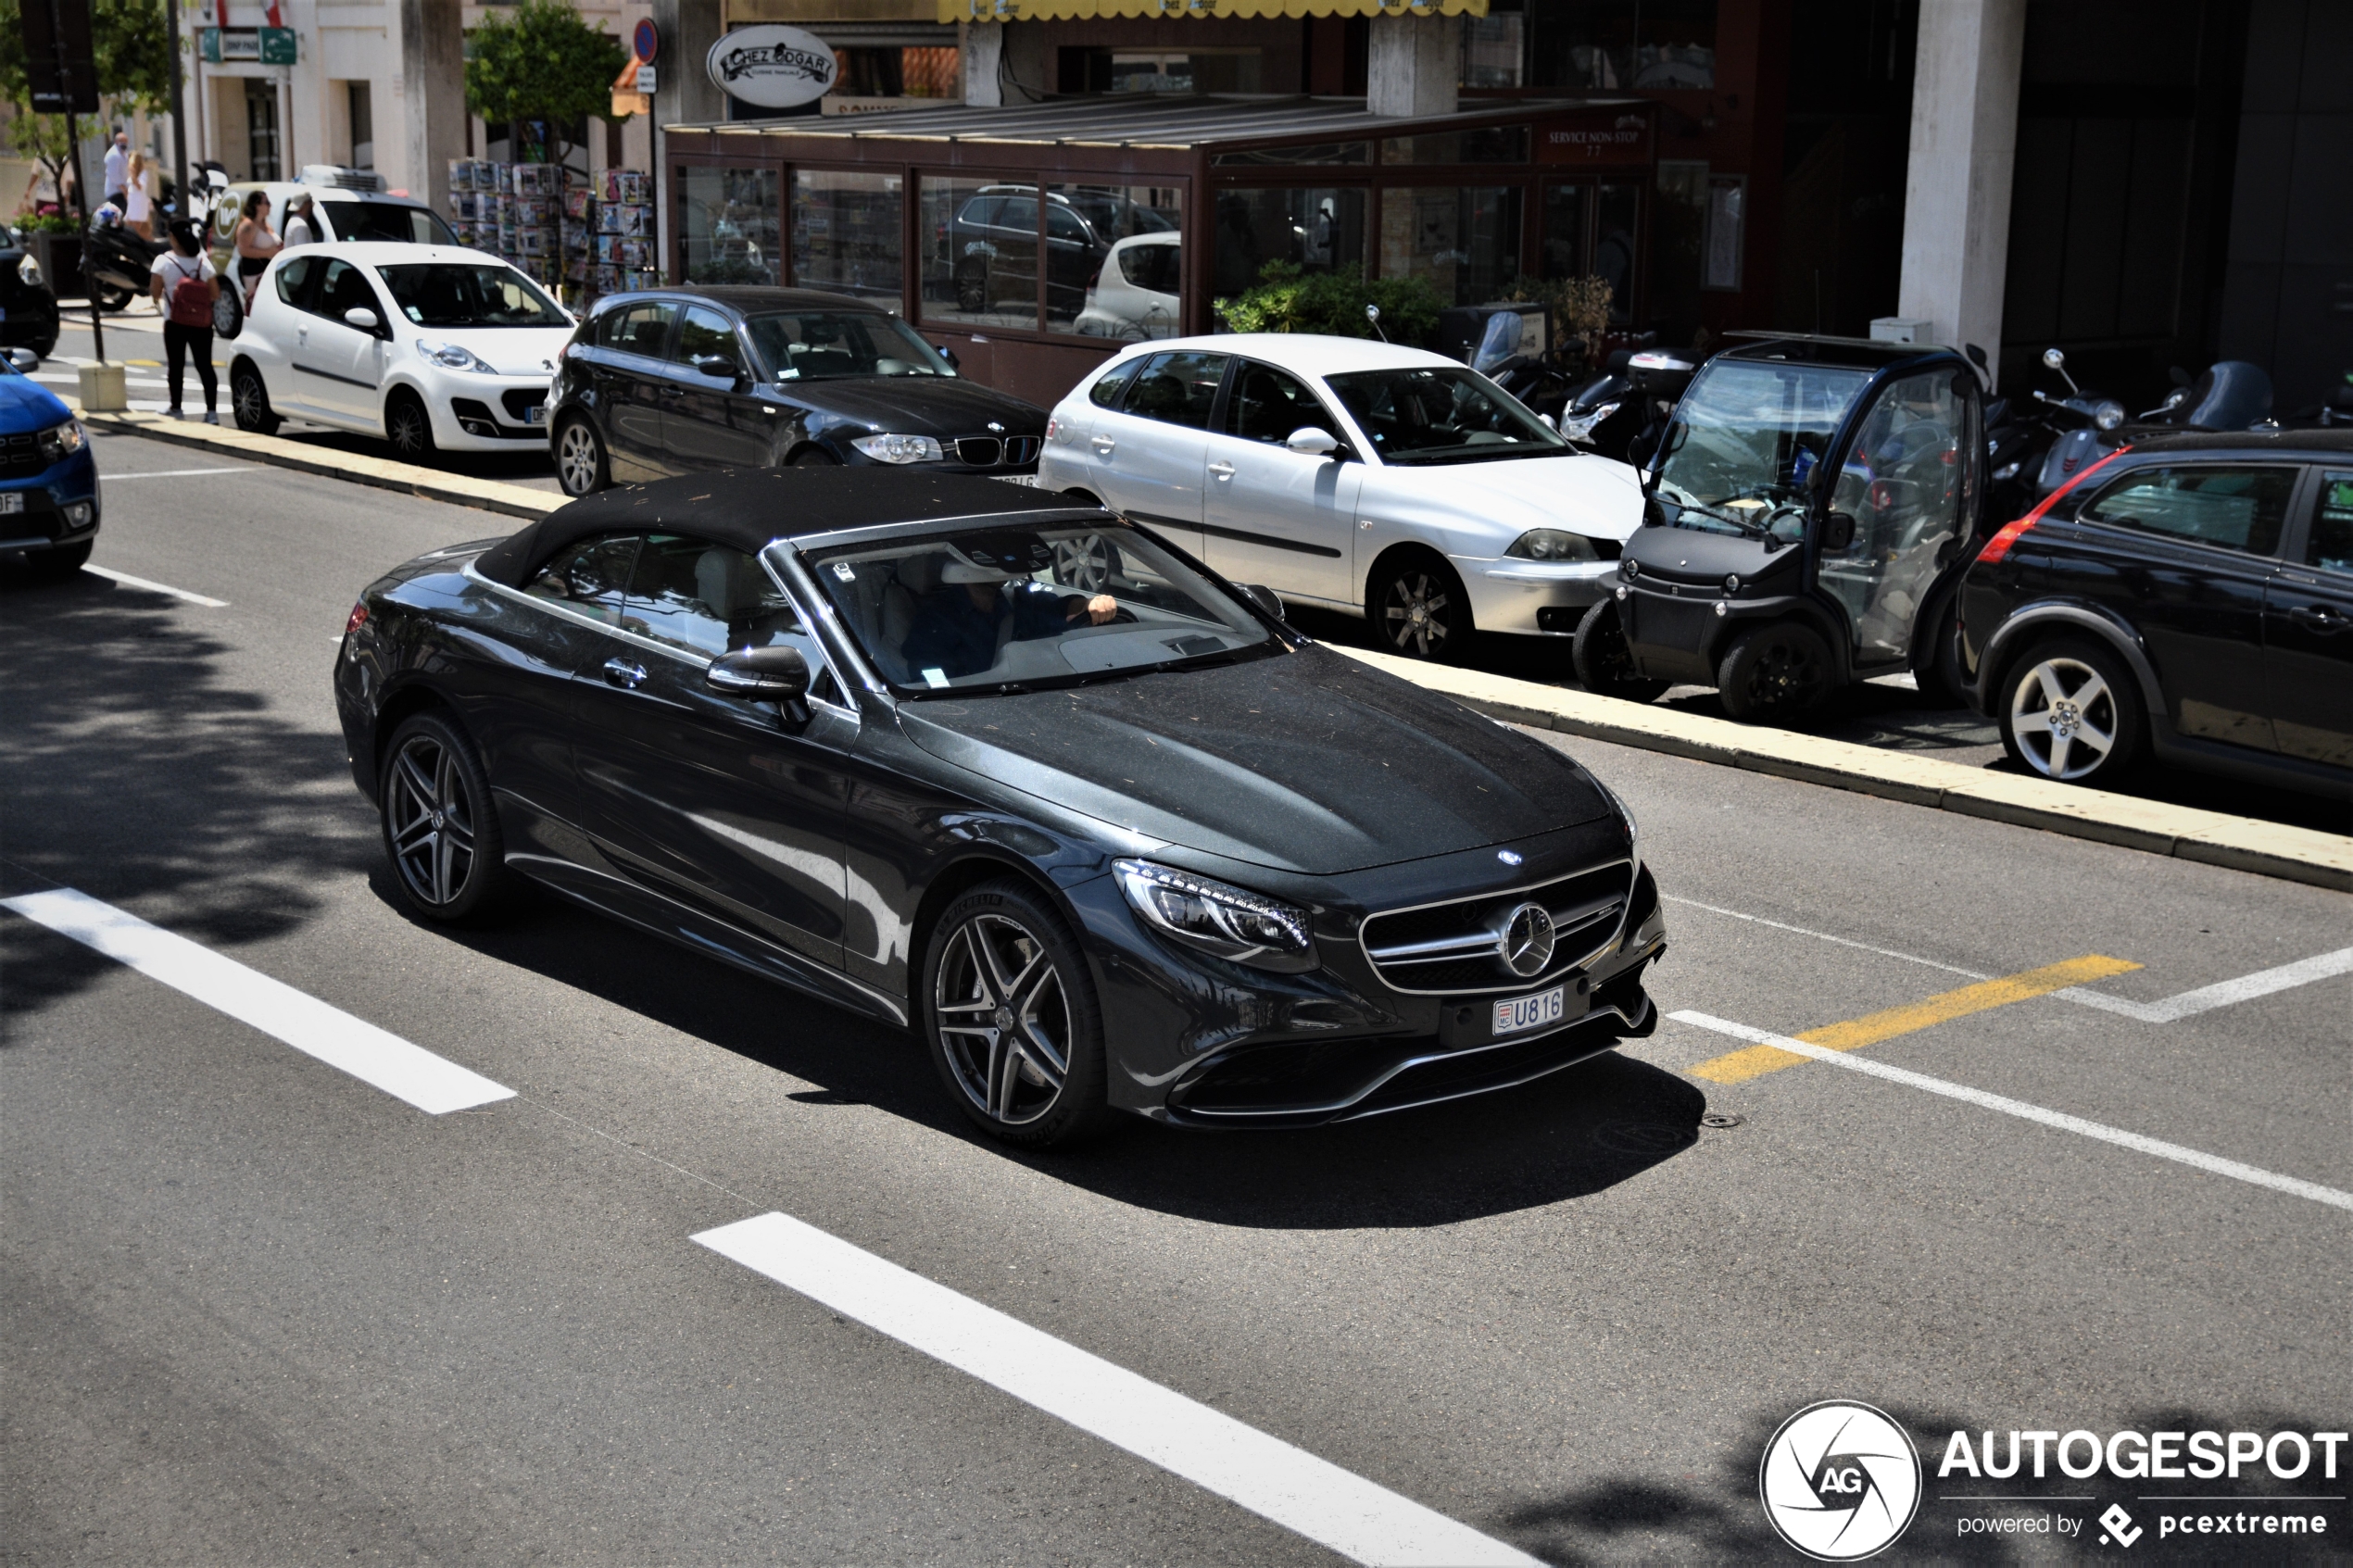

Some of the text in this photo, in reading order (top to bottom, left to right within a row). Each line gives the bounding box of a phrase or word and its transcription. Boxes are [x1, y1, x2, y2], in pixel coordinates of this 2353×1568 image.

[1549, 132, 1638, 143] SERVICE NON-STOP
[948, 894, 1001, 923] MICHELIN
[1516, 991, 1561, 1026] U816
[1500, 1017, 1509, 1025] MC
